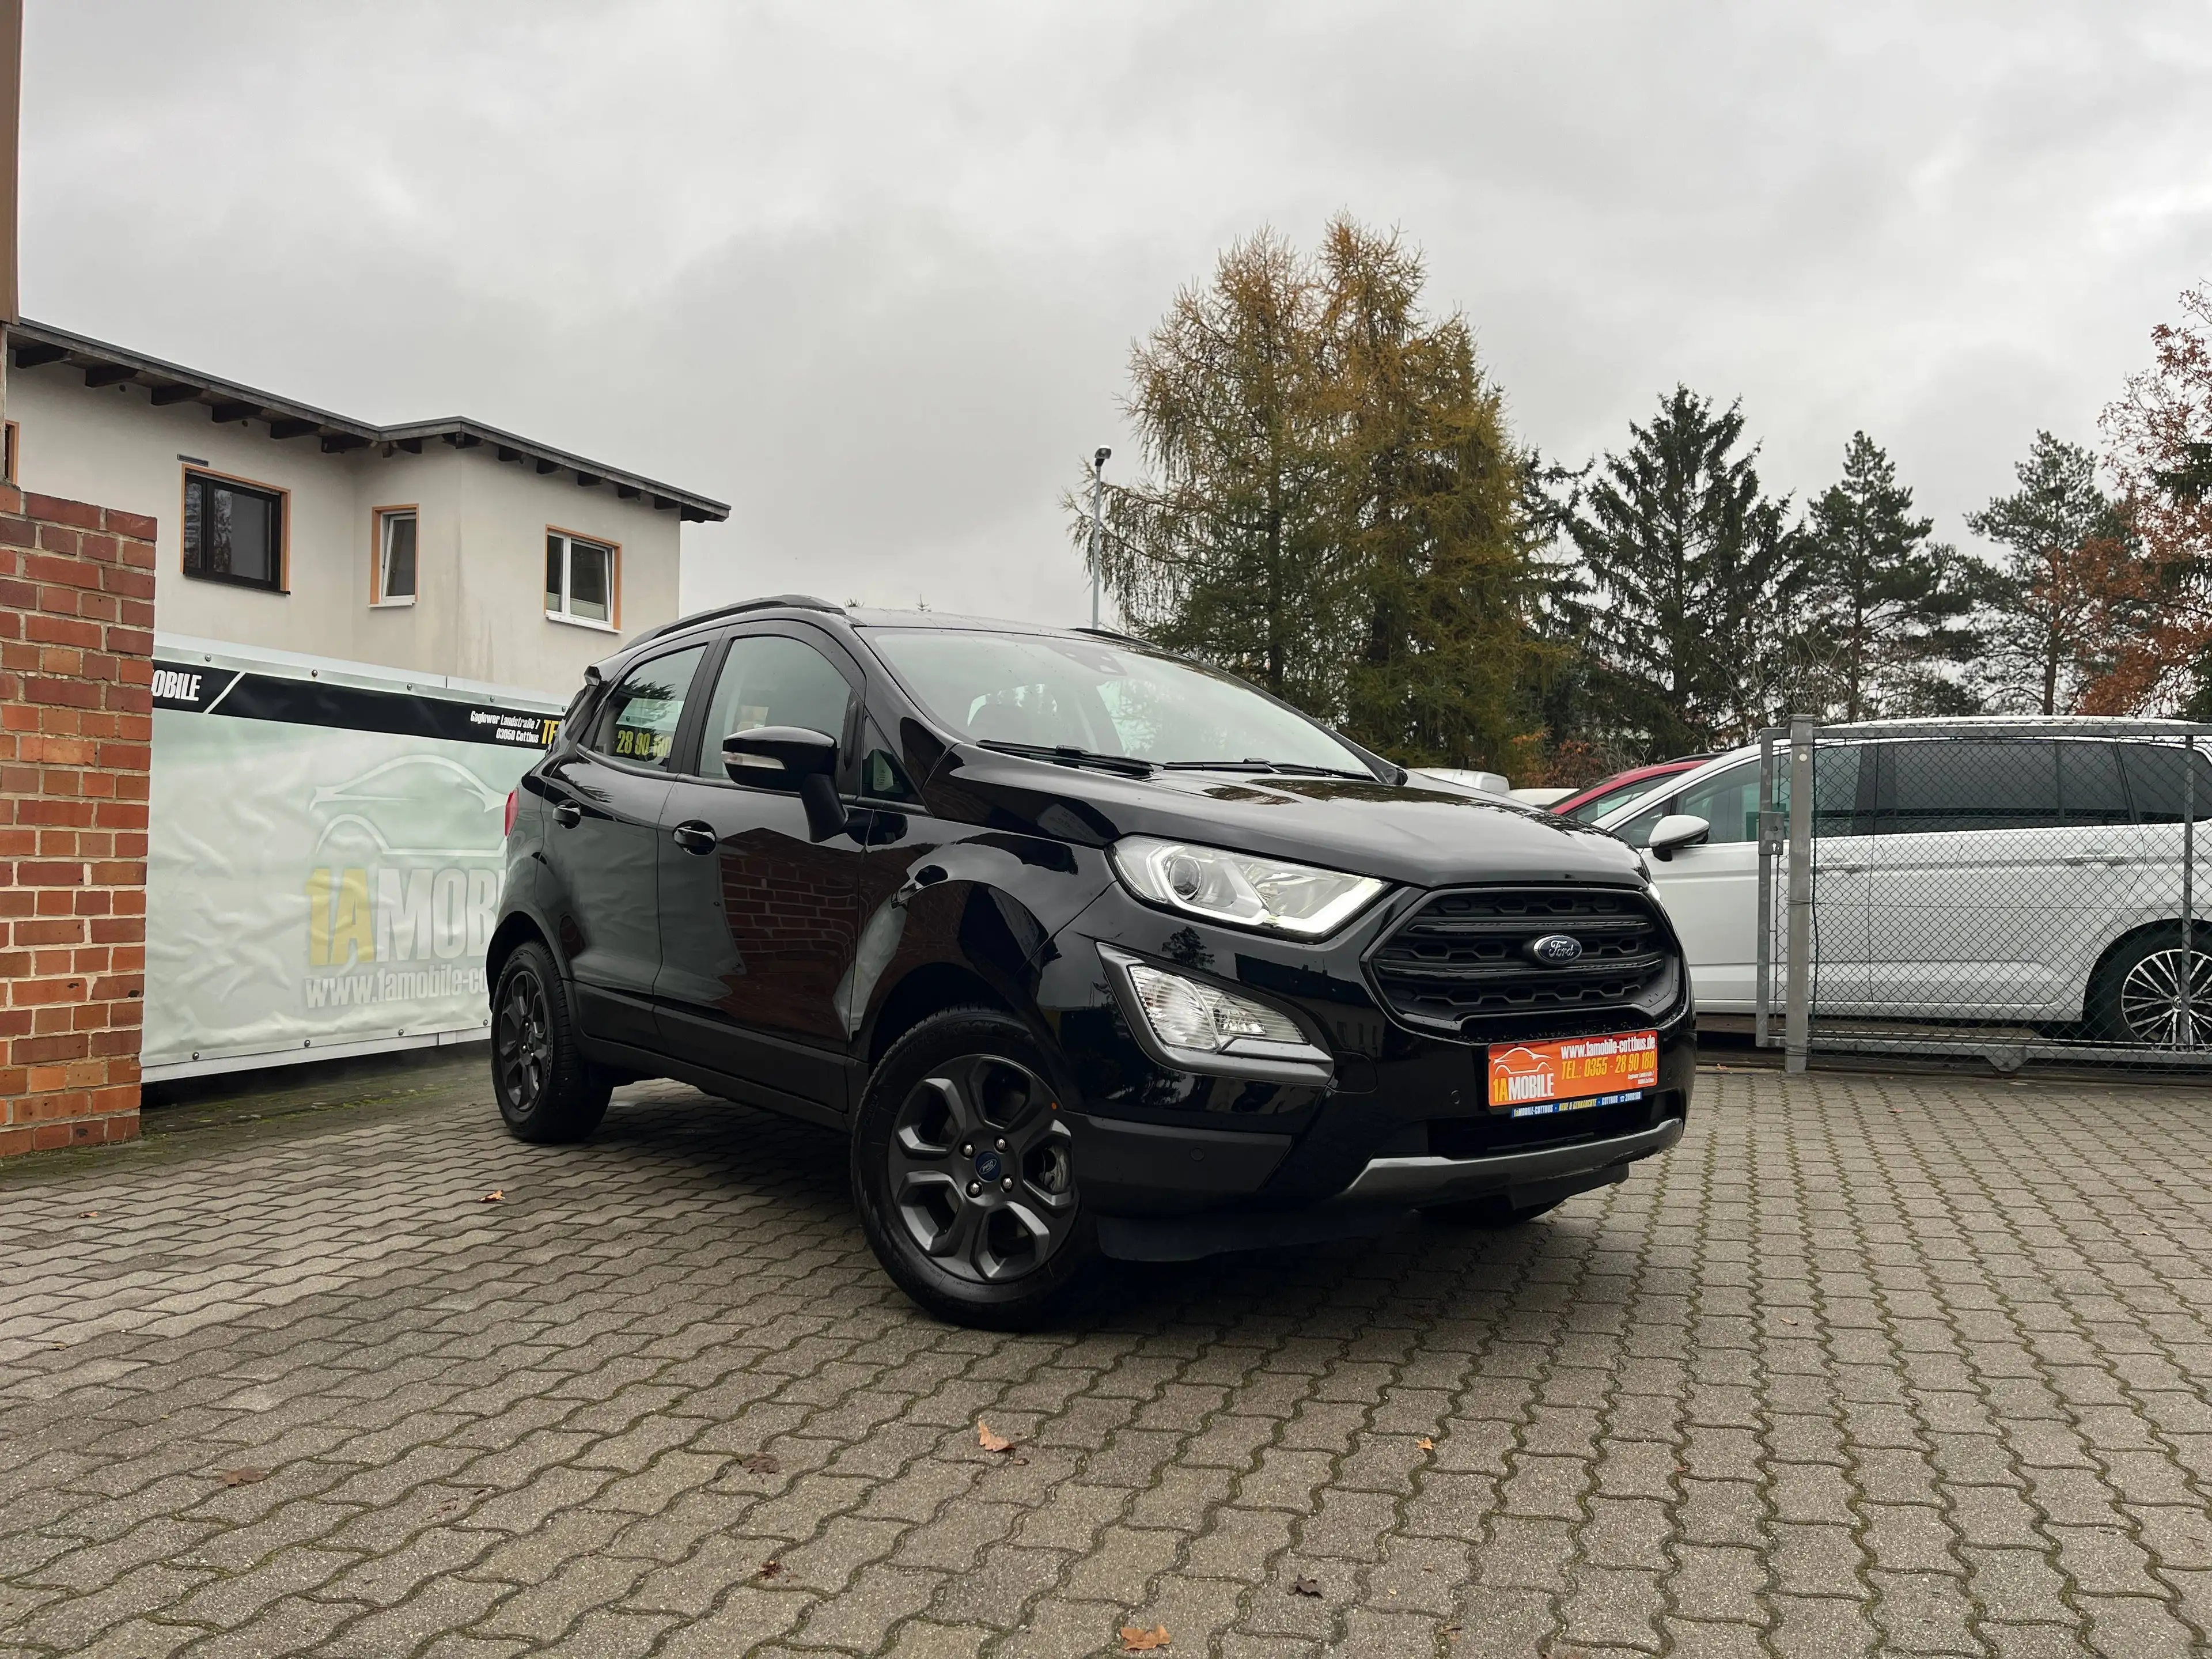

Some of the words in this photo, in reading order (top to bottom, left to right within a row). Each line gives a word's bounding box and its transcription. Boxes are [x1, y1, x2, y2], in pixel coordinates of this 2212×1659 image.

[150, 669, 202, 702] OBILE
[470, 710, 500, 725] Gaglower
[500, 714, 535, 729] Landstraße
[535, 719, 541, 730] 7
[495, 728, 516, 741] 03050
[516, 730, 539, 744] Cottbus
[616, 729, 634, 755] 28
[634, 732, 651, 756] 90
[1548, 940, 1574, 957] Ford
[1560, 1035, 1655, 1059] www.1amobile-cottbus.de
[1584, 1056, 1608, 1077] 0355
[1615, 1055, 1627, 1074] 28
[1628, 1052, 1640, 1071] 90
[1641, 1051, 1655, 1070] 180
[1493, 1073, 1554, 1102] 1AMOBILE
